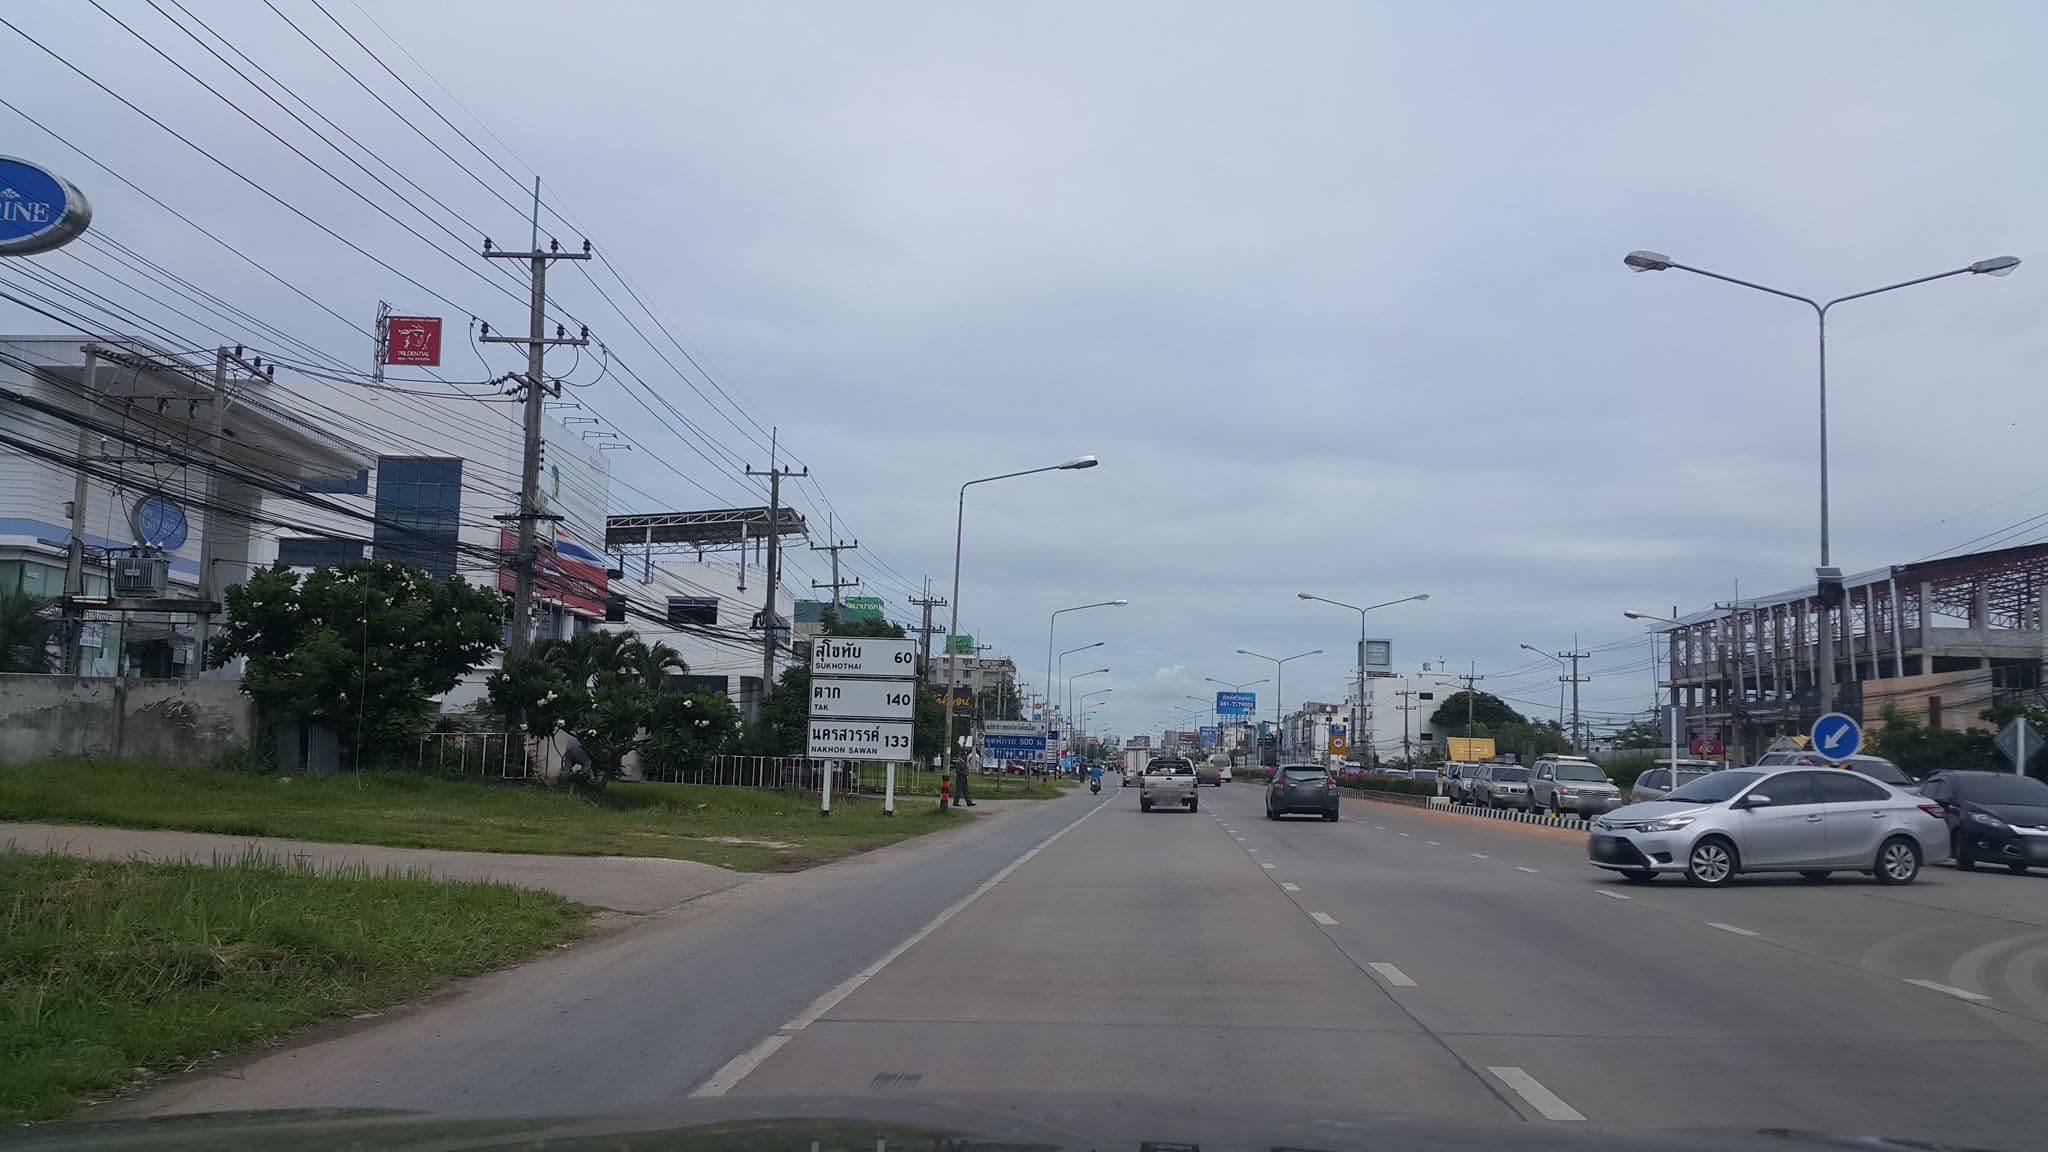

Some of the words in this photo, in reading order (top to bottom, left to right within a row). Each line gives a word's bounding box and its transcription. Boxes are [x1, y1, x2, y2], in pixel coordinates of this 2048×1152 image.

[0, 201, 50, 223] INE
[815, 639, 862, 663] สุโขทัย
[894, 652, 912, 664] 60
[814, 686, 841, 699] ตาก
[886, 693, 911, 706] 140
[814, 703, 829, 711] TAK
[812, 726, 881, 743] นครสวรรค์
[884, 735, 909, 748] 133
[1020, 738, 1034, 746] 500
[811, 746, 845, 754] NAKHON
[848, 747, 878, 755] SAWAN
